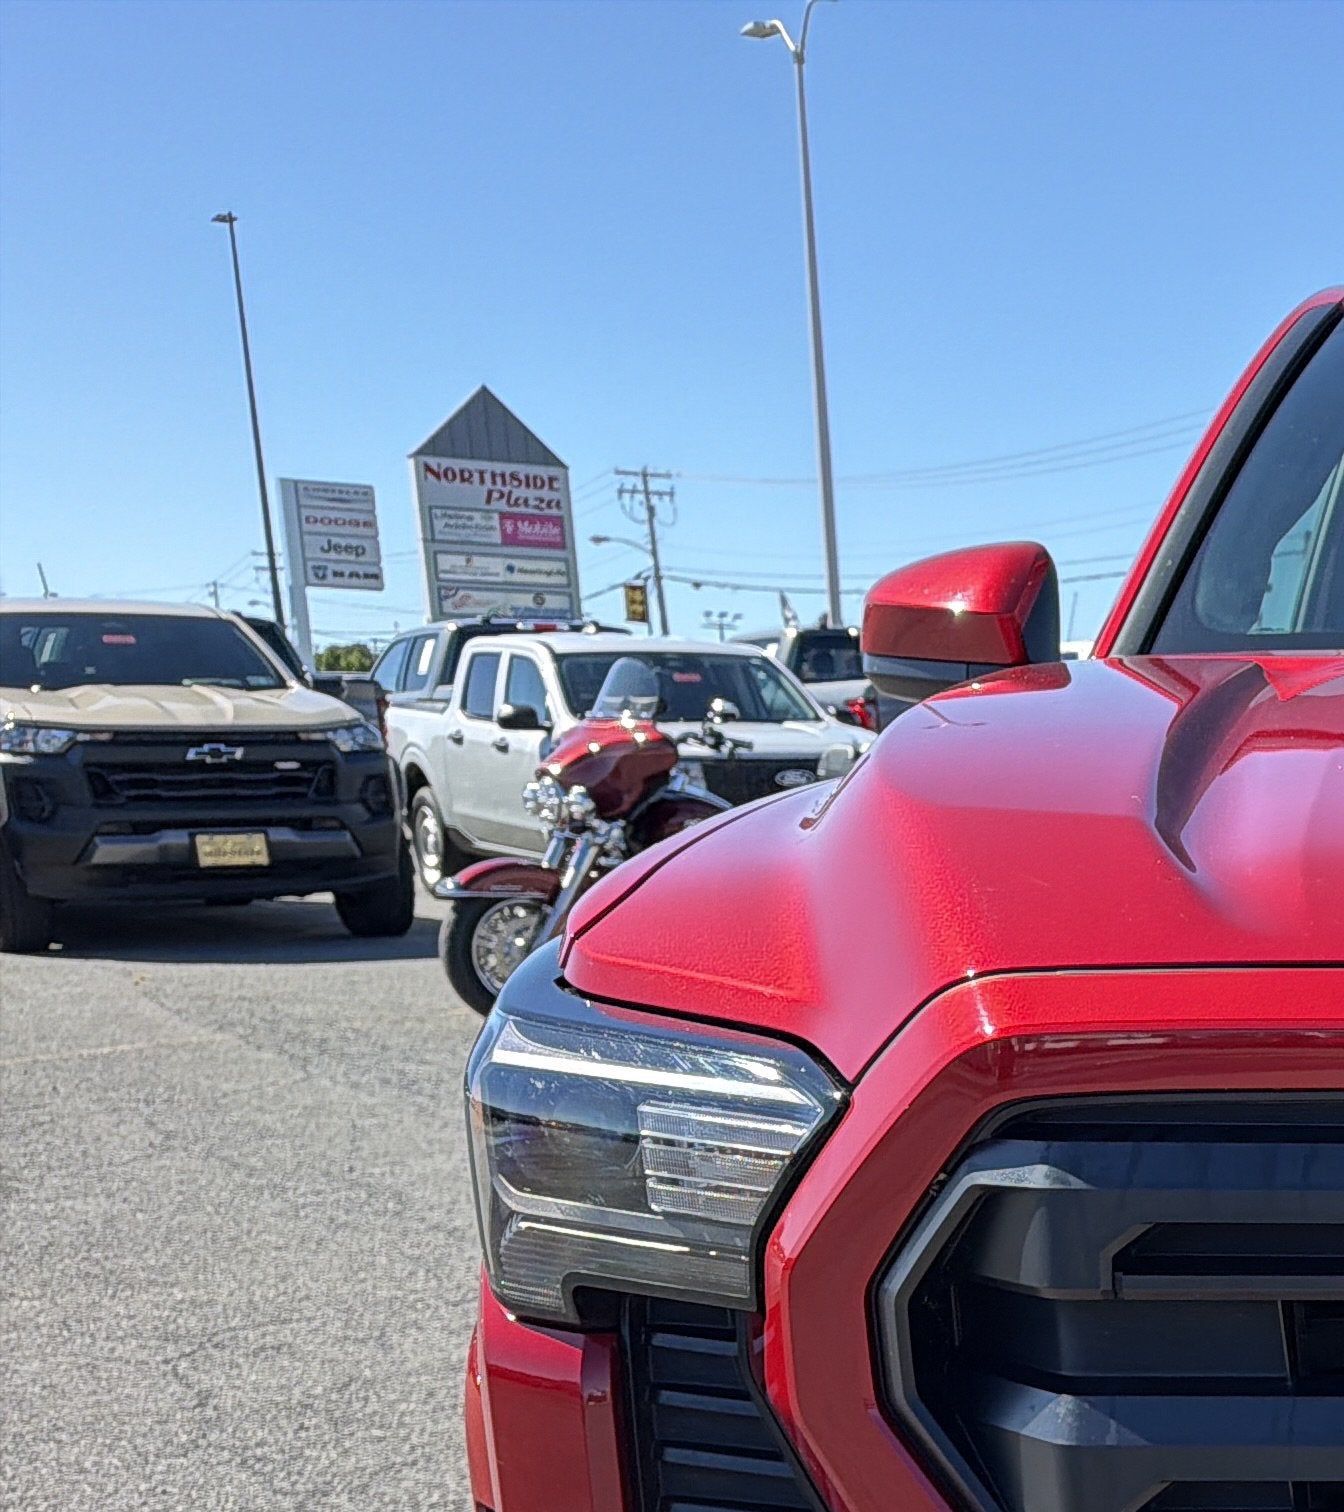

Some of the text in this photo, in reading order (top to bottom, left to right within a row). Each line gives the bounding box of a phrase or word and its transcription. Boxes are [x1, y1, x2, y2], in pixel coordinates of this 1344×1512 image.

[423, 462, 561, 491] NORTHSIDE
[485, 488, 563, 511] Plaza
[320, 538, 366, 557] Jeep
